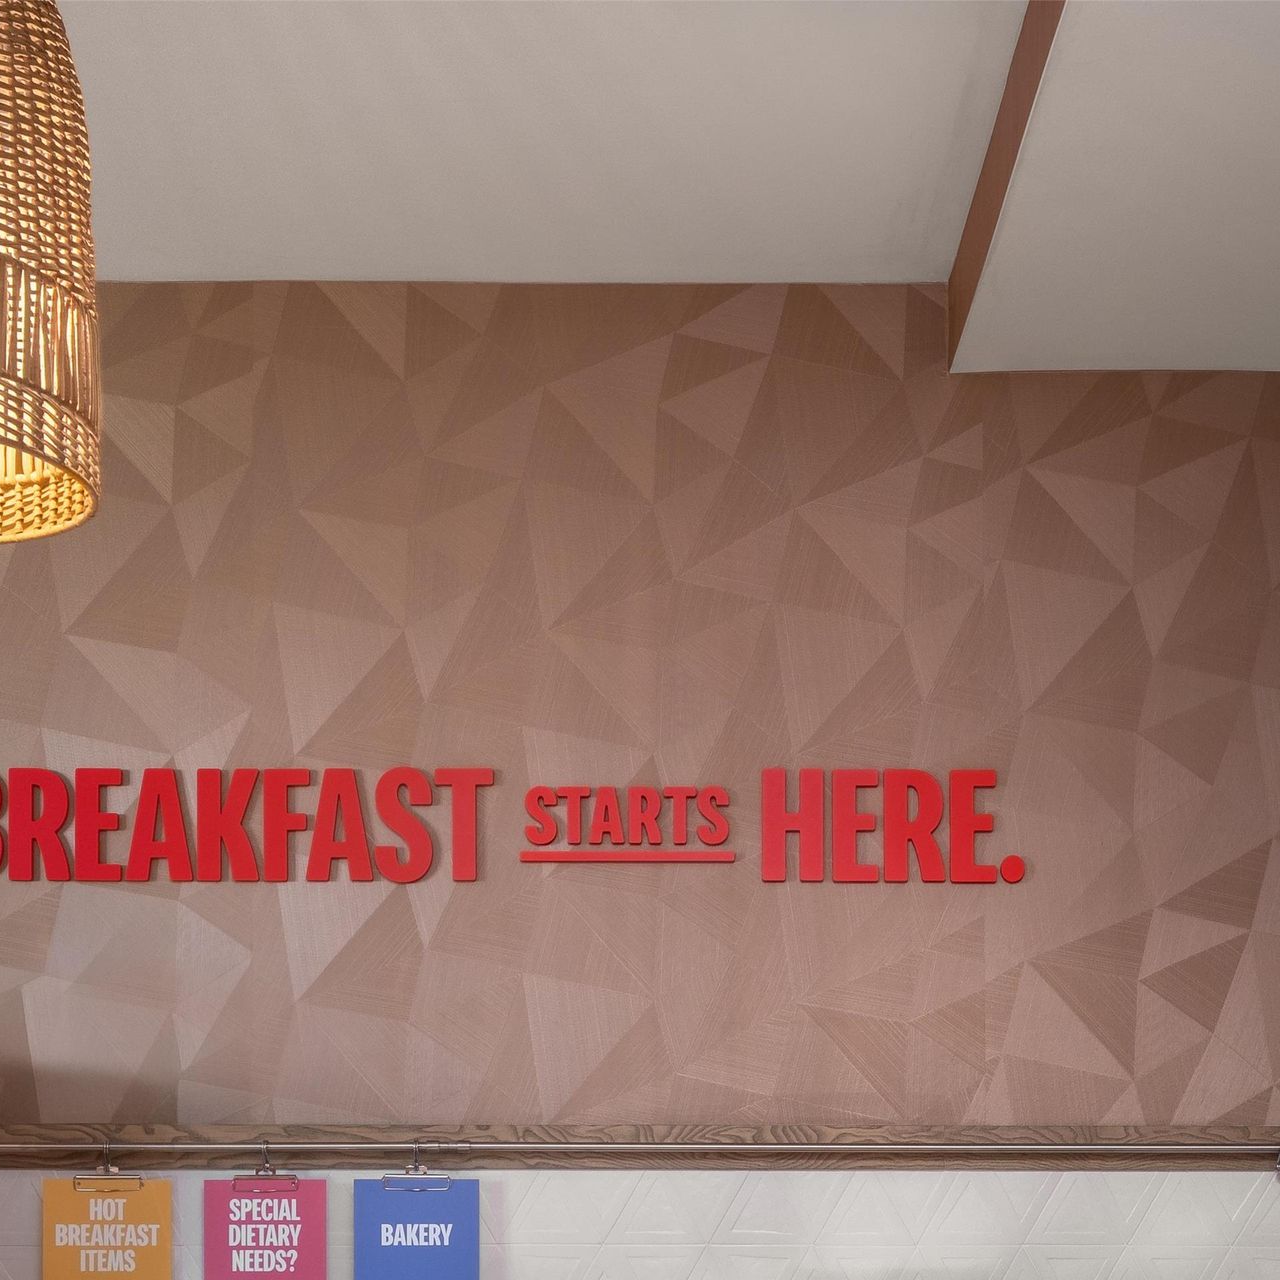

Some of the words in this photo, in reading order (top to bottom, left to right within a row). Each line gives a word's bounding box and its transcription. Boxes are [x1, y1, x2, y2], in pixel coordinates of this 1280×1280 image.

[523, 784, 731, 846] STARTS
[758, 767, 1027, 884] HERE.
[89, 1198, 126, 1221] HOT
[229, 1198, 301, 1222] SPECIAL
[55, 1224, 160, 1247] BREAKFAST
[228, 1223, 302, 1247] DIETARY
[381, 1223, 453, 1246] BAKERY
[80, 1249, 136, 1272] ITEMS
[231, 1249, 298, 1273] NEEDS?
